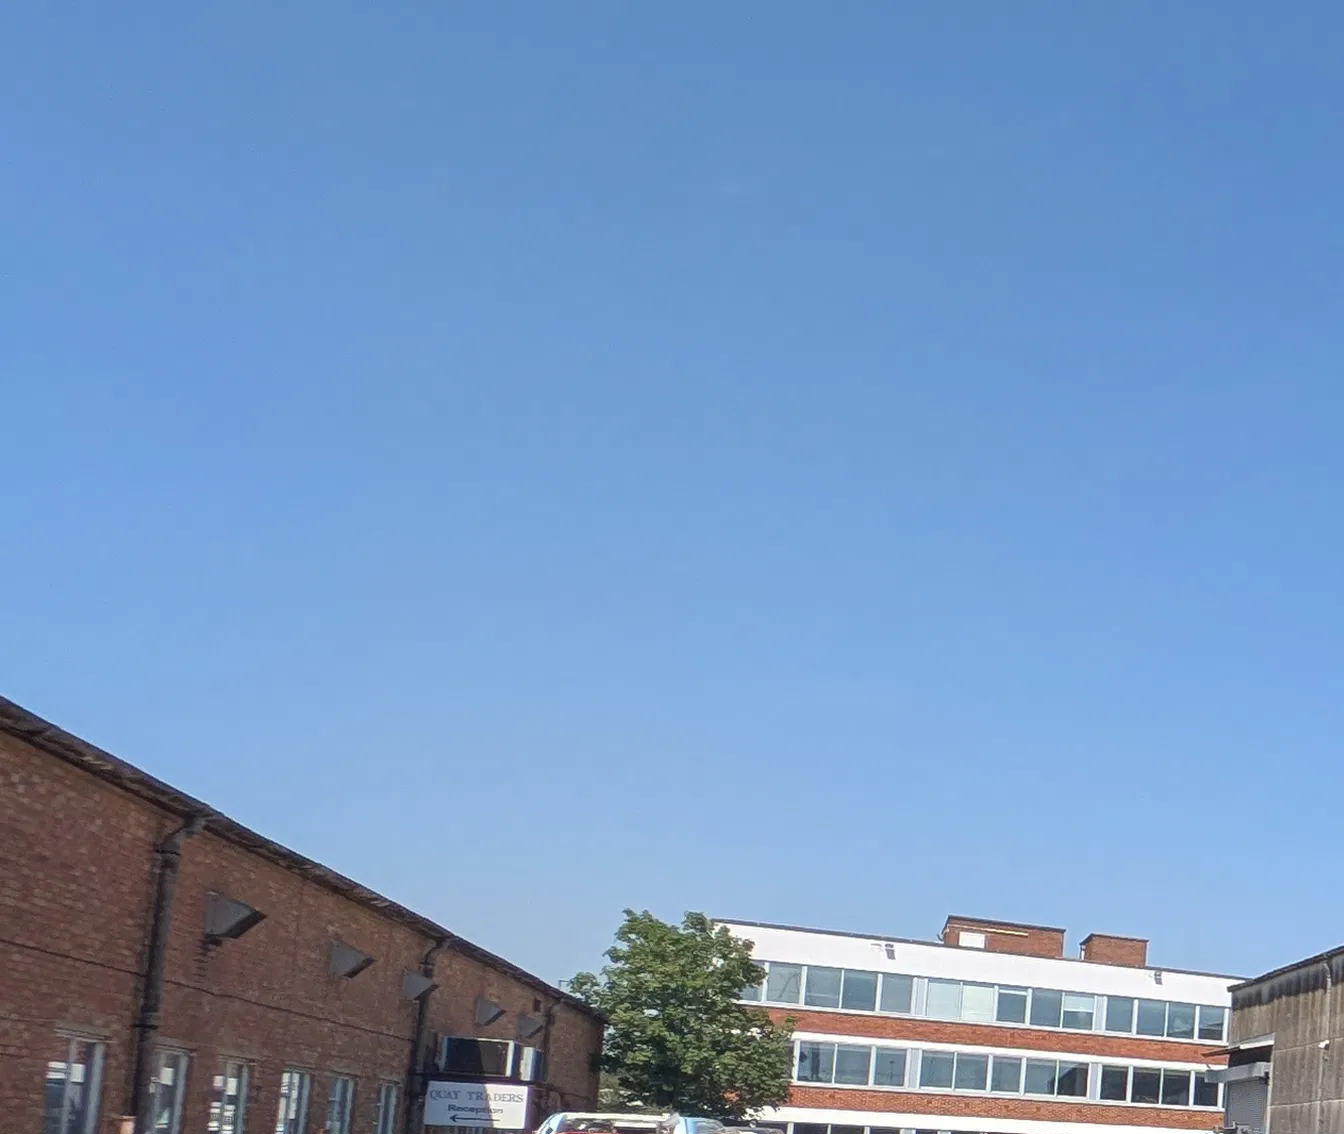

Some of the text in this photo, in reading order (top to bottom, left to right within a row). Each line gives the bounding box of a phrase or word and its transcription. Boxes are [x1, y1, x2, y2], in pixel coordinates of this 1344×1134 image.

[429, 1088, 524, 1103] QUAY TRADERS
[447, 1104, 504, 1115] Reception
